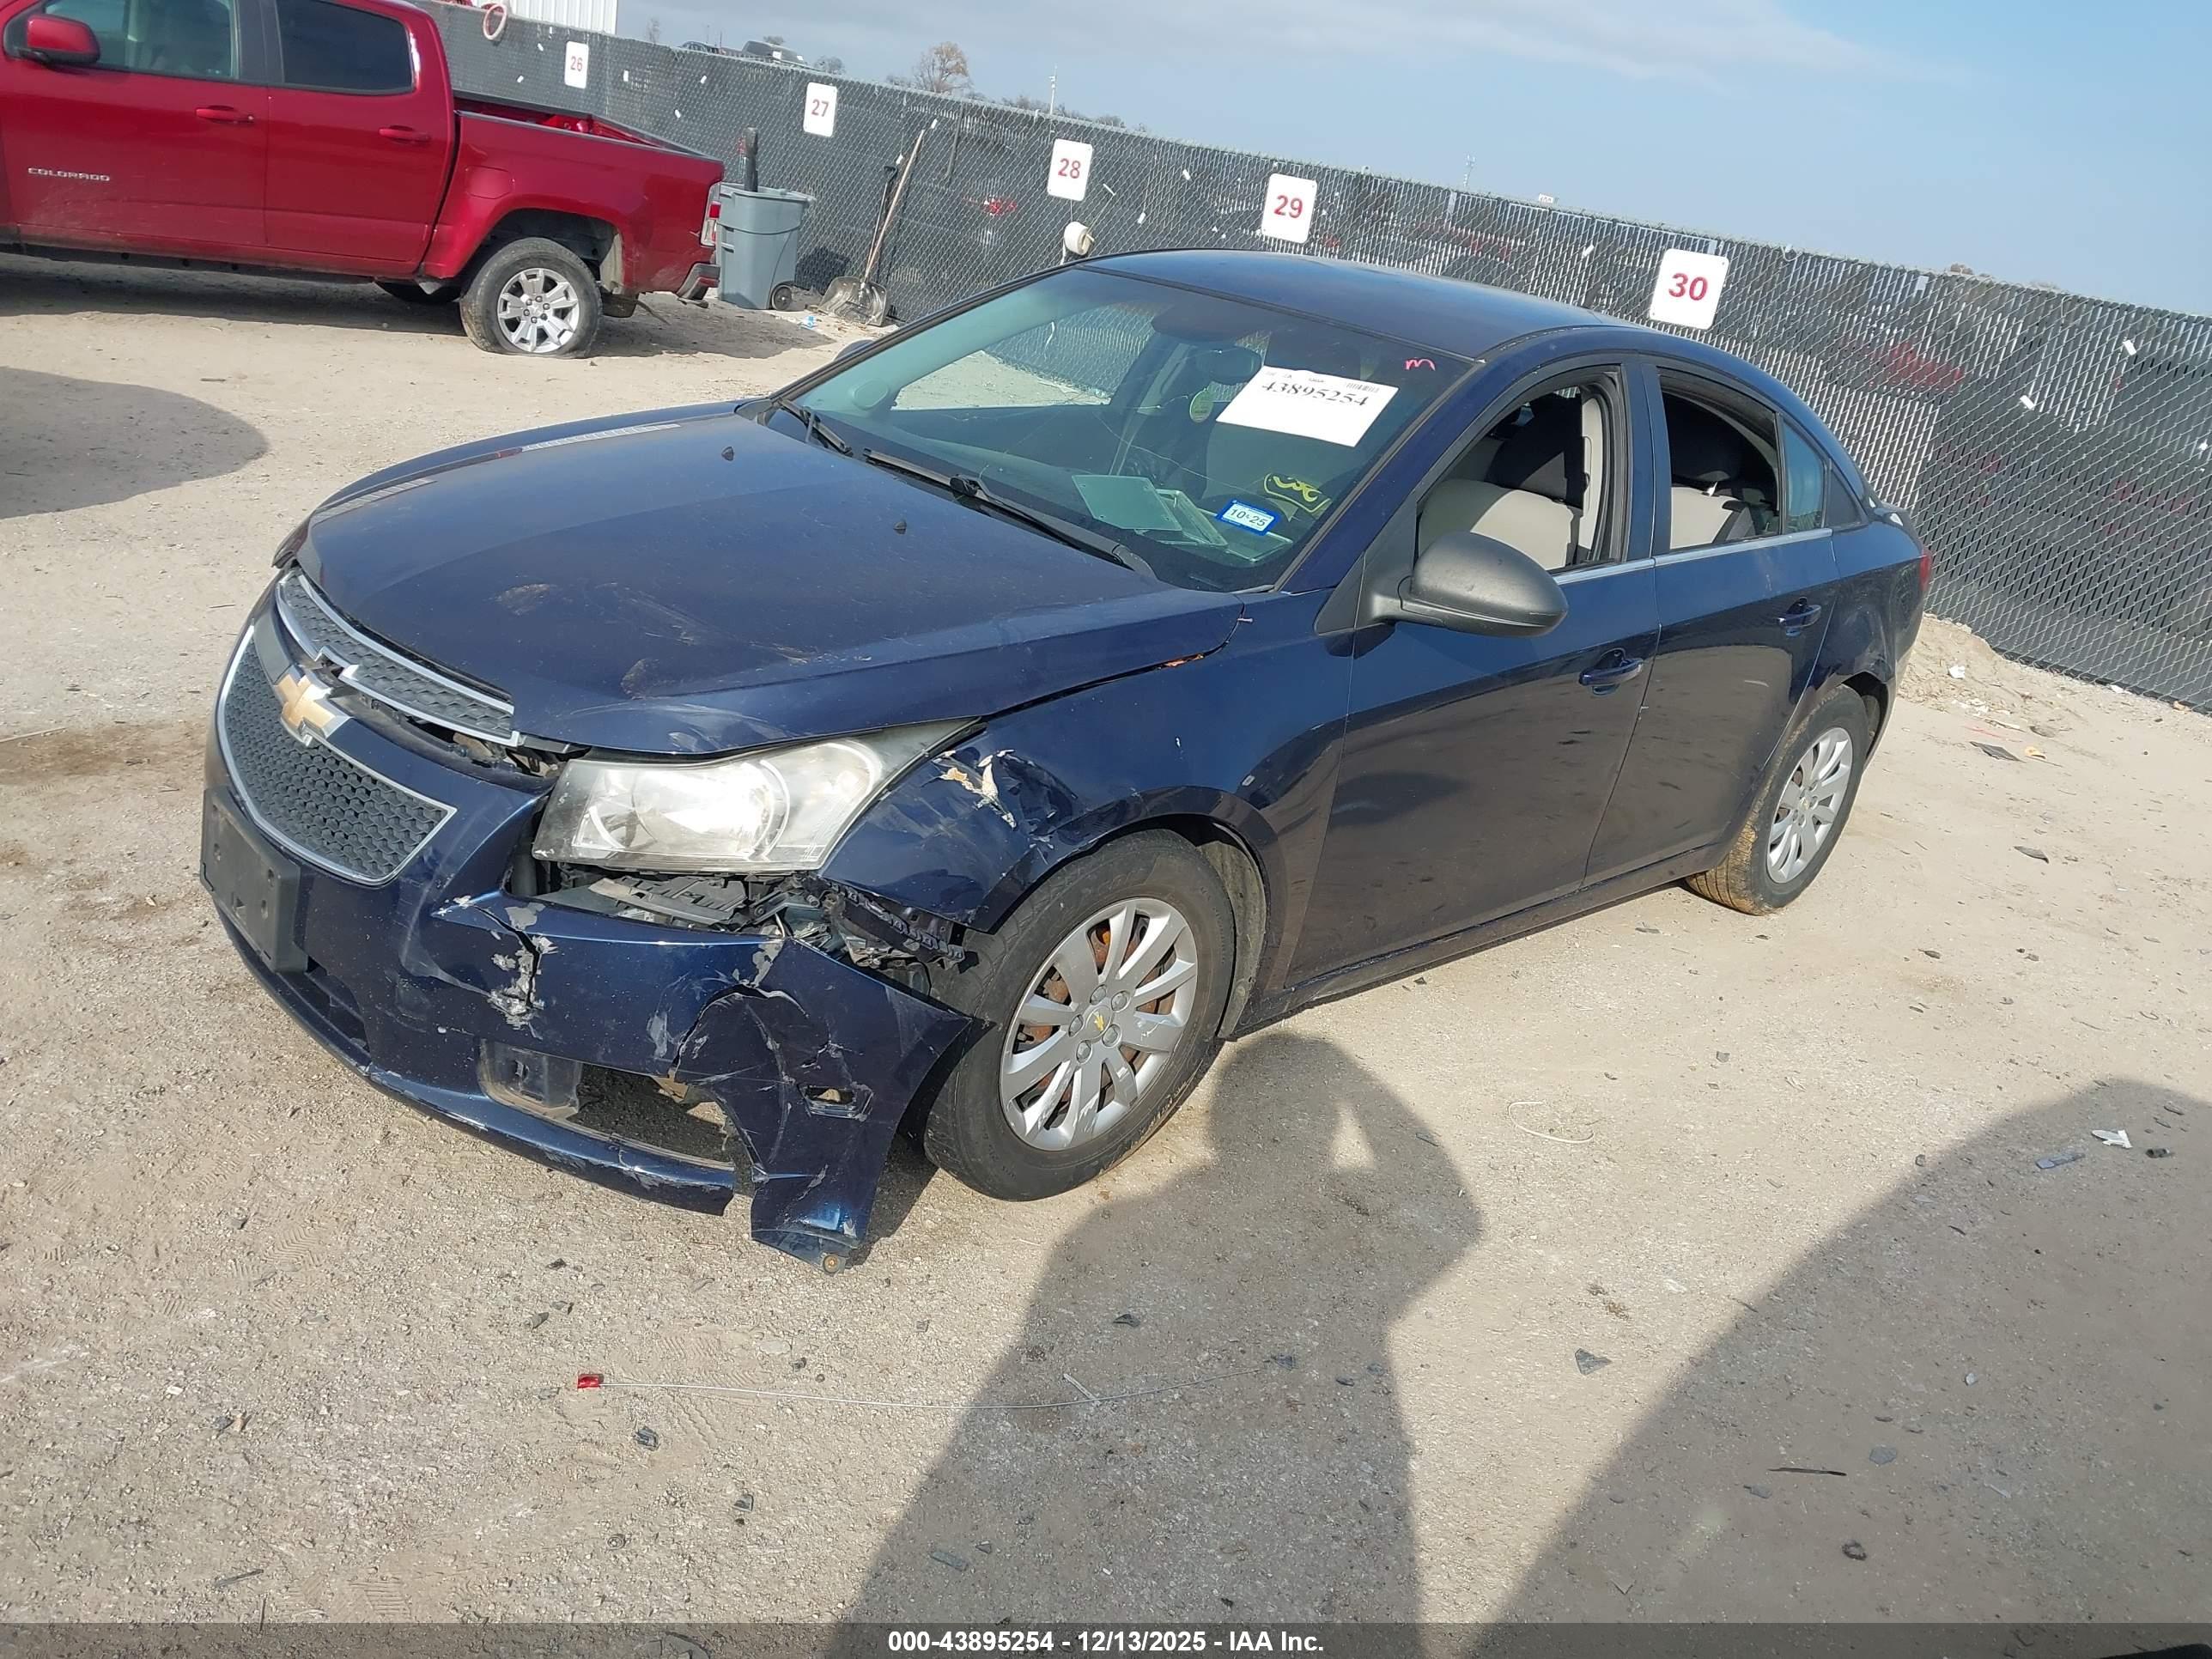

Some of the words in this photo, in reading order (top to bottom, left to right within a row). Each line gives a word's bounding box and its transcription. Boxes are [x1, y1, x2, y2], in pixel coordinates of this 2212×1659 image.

[570, 56, 583, 72] 26
[811, 99, 830, 117] 27
[27, 167, 110, 181] COLORADO
[1058, 158, 1081, 179] 28
[1273, 194, 1304, 219] 29
[1668, 272, 1709, 301] 30
[1261, 380, 1369, 406] 43895254
